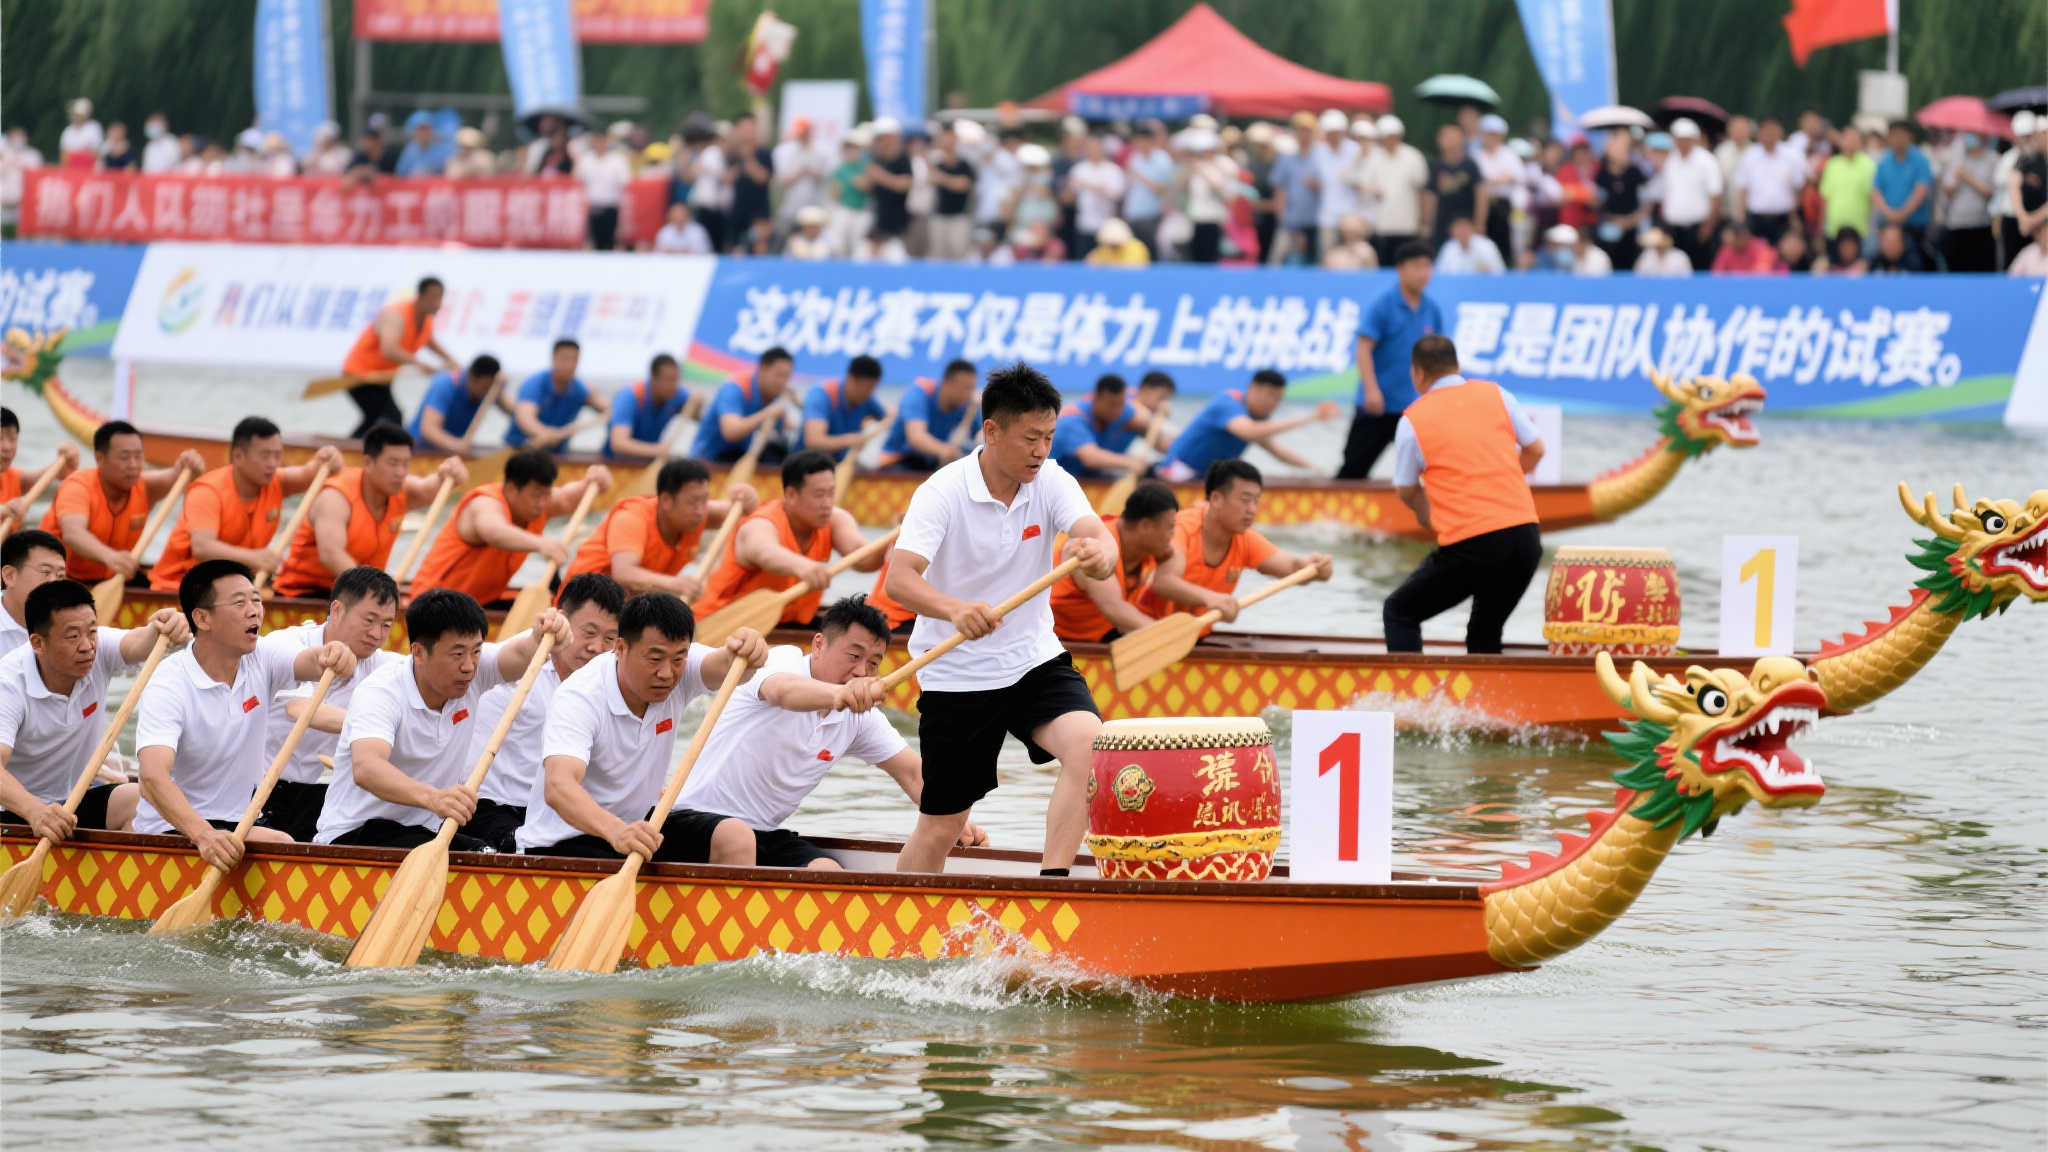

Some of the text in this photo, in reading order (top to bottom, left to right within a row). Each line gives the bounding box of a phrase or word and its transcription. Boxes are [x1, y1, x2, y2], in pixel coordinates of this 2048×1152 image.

[728, 285, 1359, 374] 这次比赛不仅是体力上的挑战
[1454, 302, 1962, 387] 更是团队协作的试赛。
[1739, 548, 1776, 648] 1
[1318, 732, 1361, 861] 1
